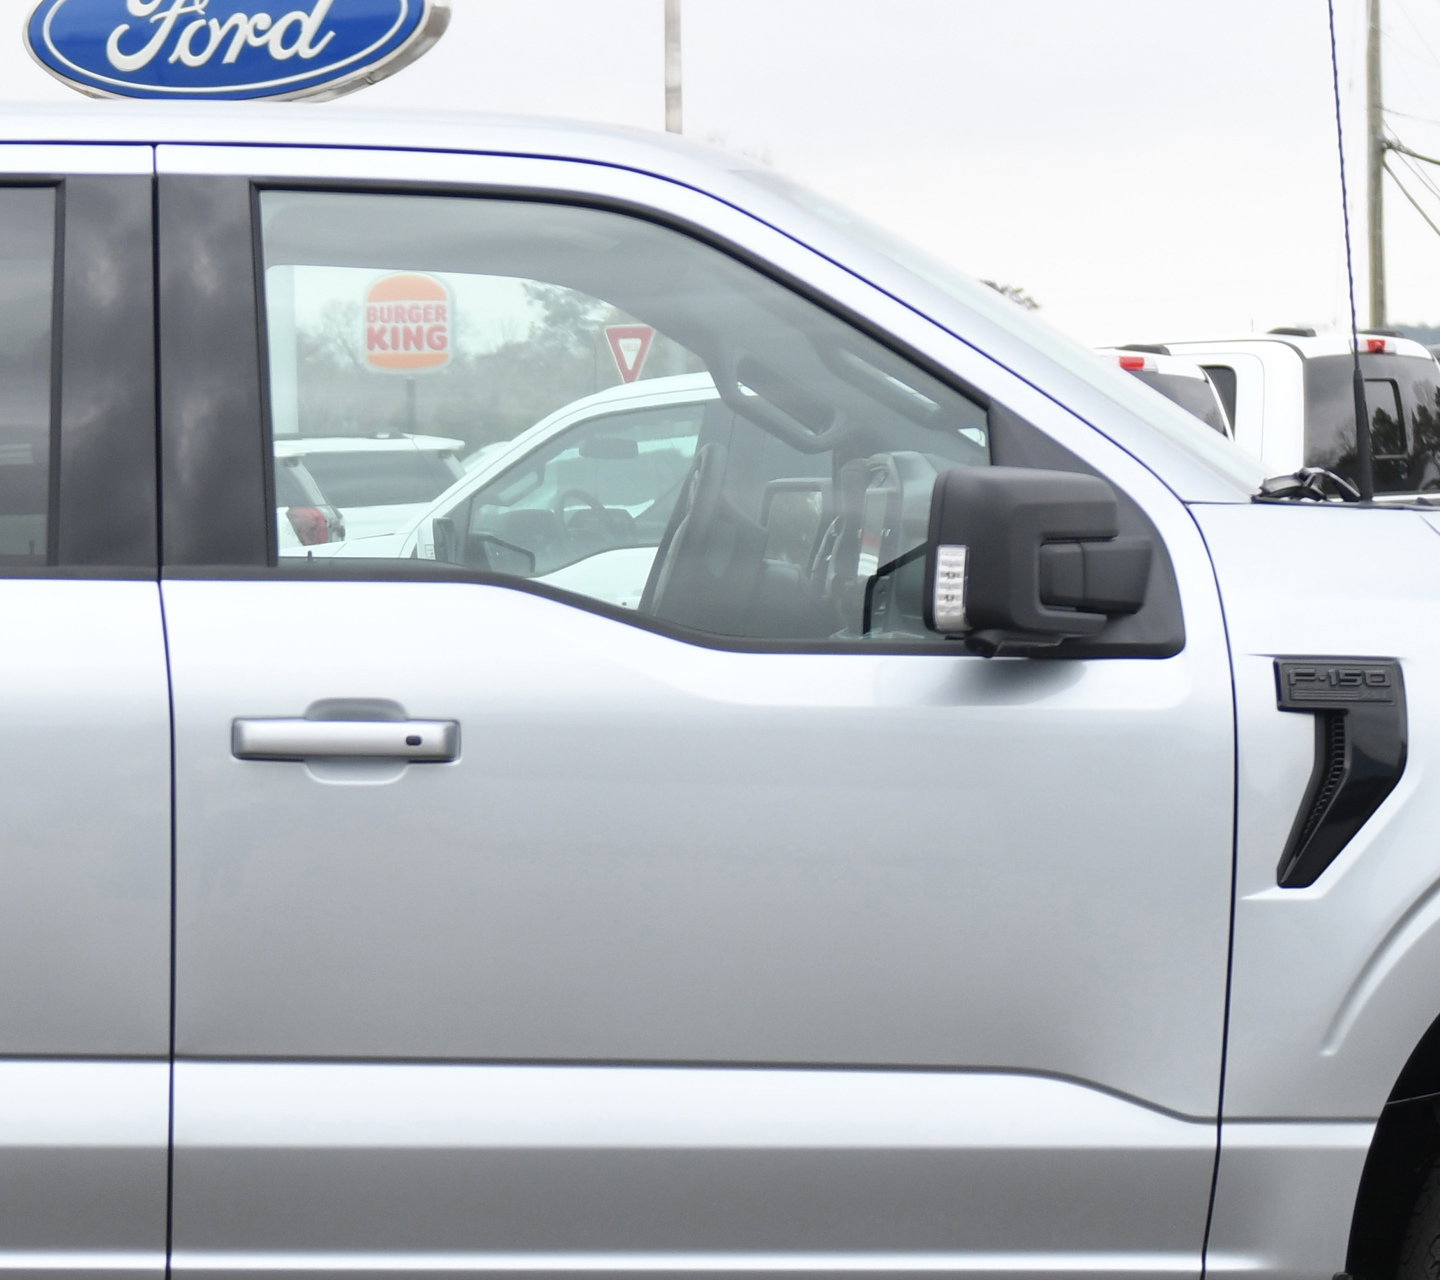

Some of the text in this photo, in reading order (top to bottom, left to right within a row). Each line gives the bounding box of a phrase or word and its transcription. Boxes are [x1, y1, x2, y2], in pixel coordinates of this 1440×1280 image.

[367, 304, 448, 323] BURGER
[367, 325, 448, 350] KING
[1288, 668, 1391, 688] F-150
